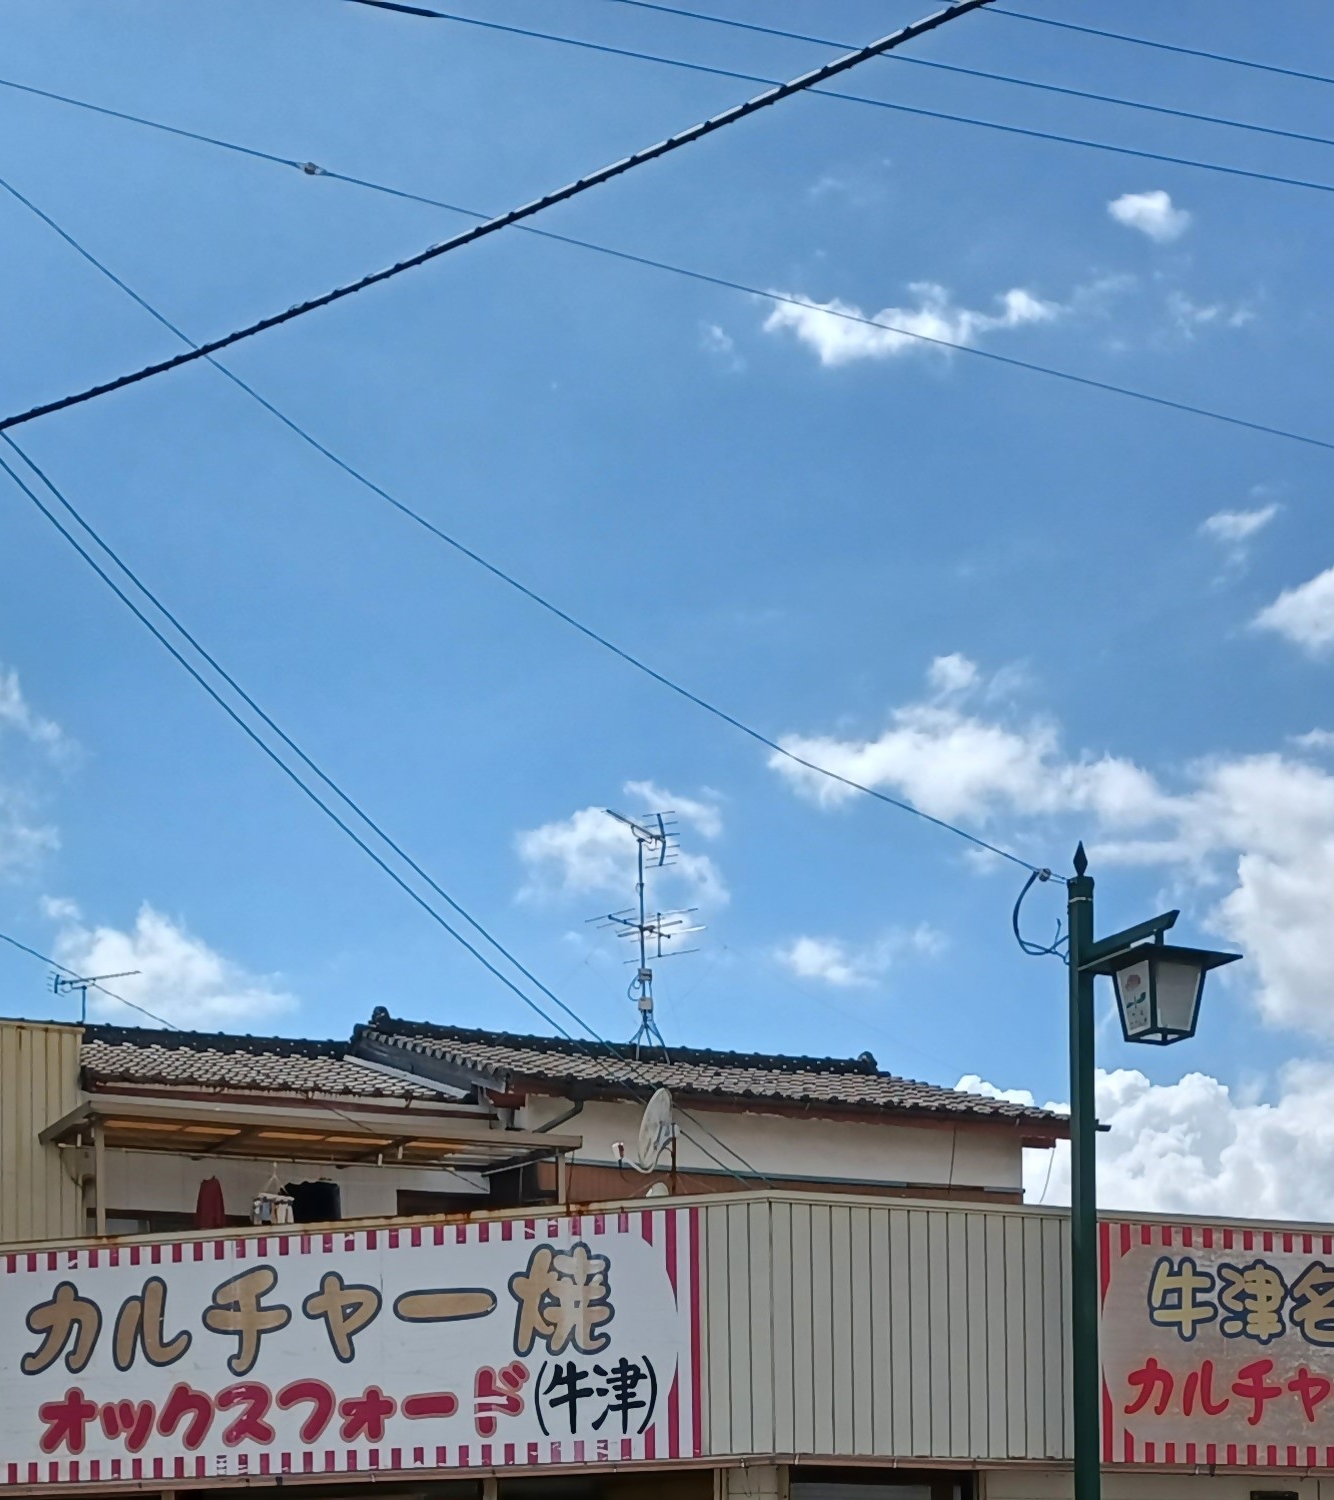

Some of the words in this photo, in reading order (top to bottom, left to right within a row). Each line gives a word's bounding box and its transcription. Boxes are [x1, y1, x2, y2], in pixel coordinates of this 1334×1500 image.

[20, 1242, 615, 1376] カルチャー焼
[38, 1359, 531, 1454] オックスフォード
[534, 1355, 658, 1436] (牛津)
